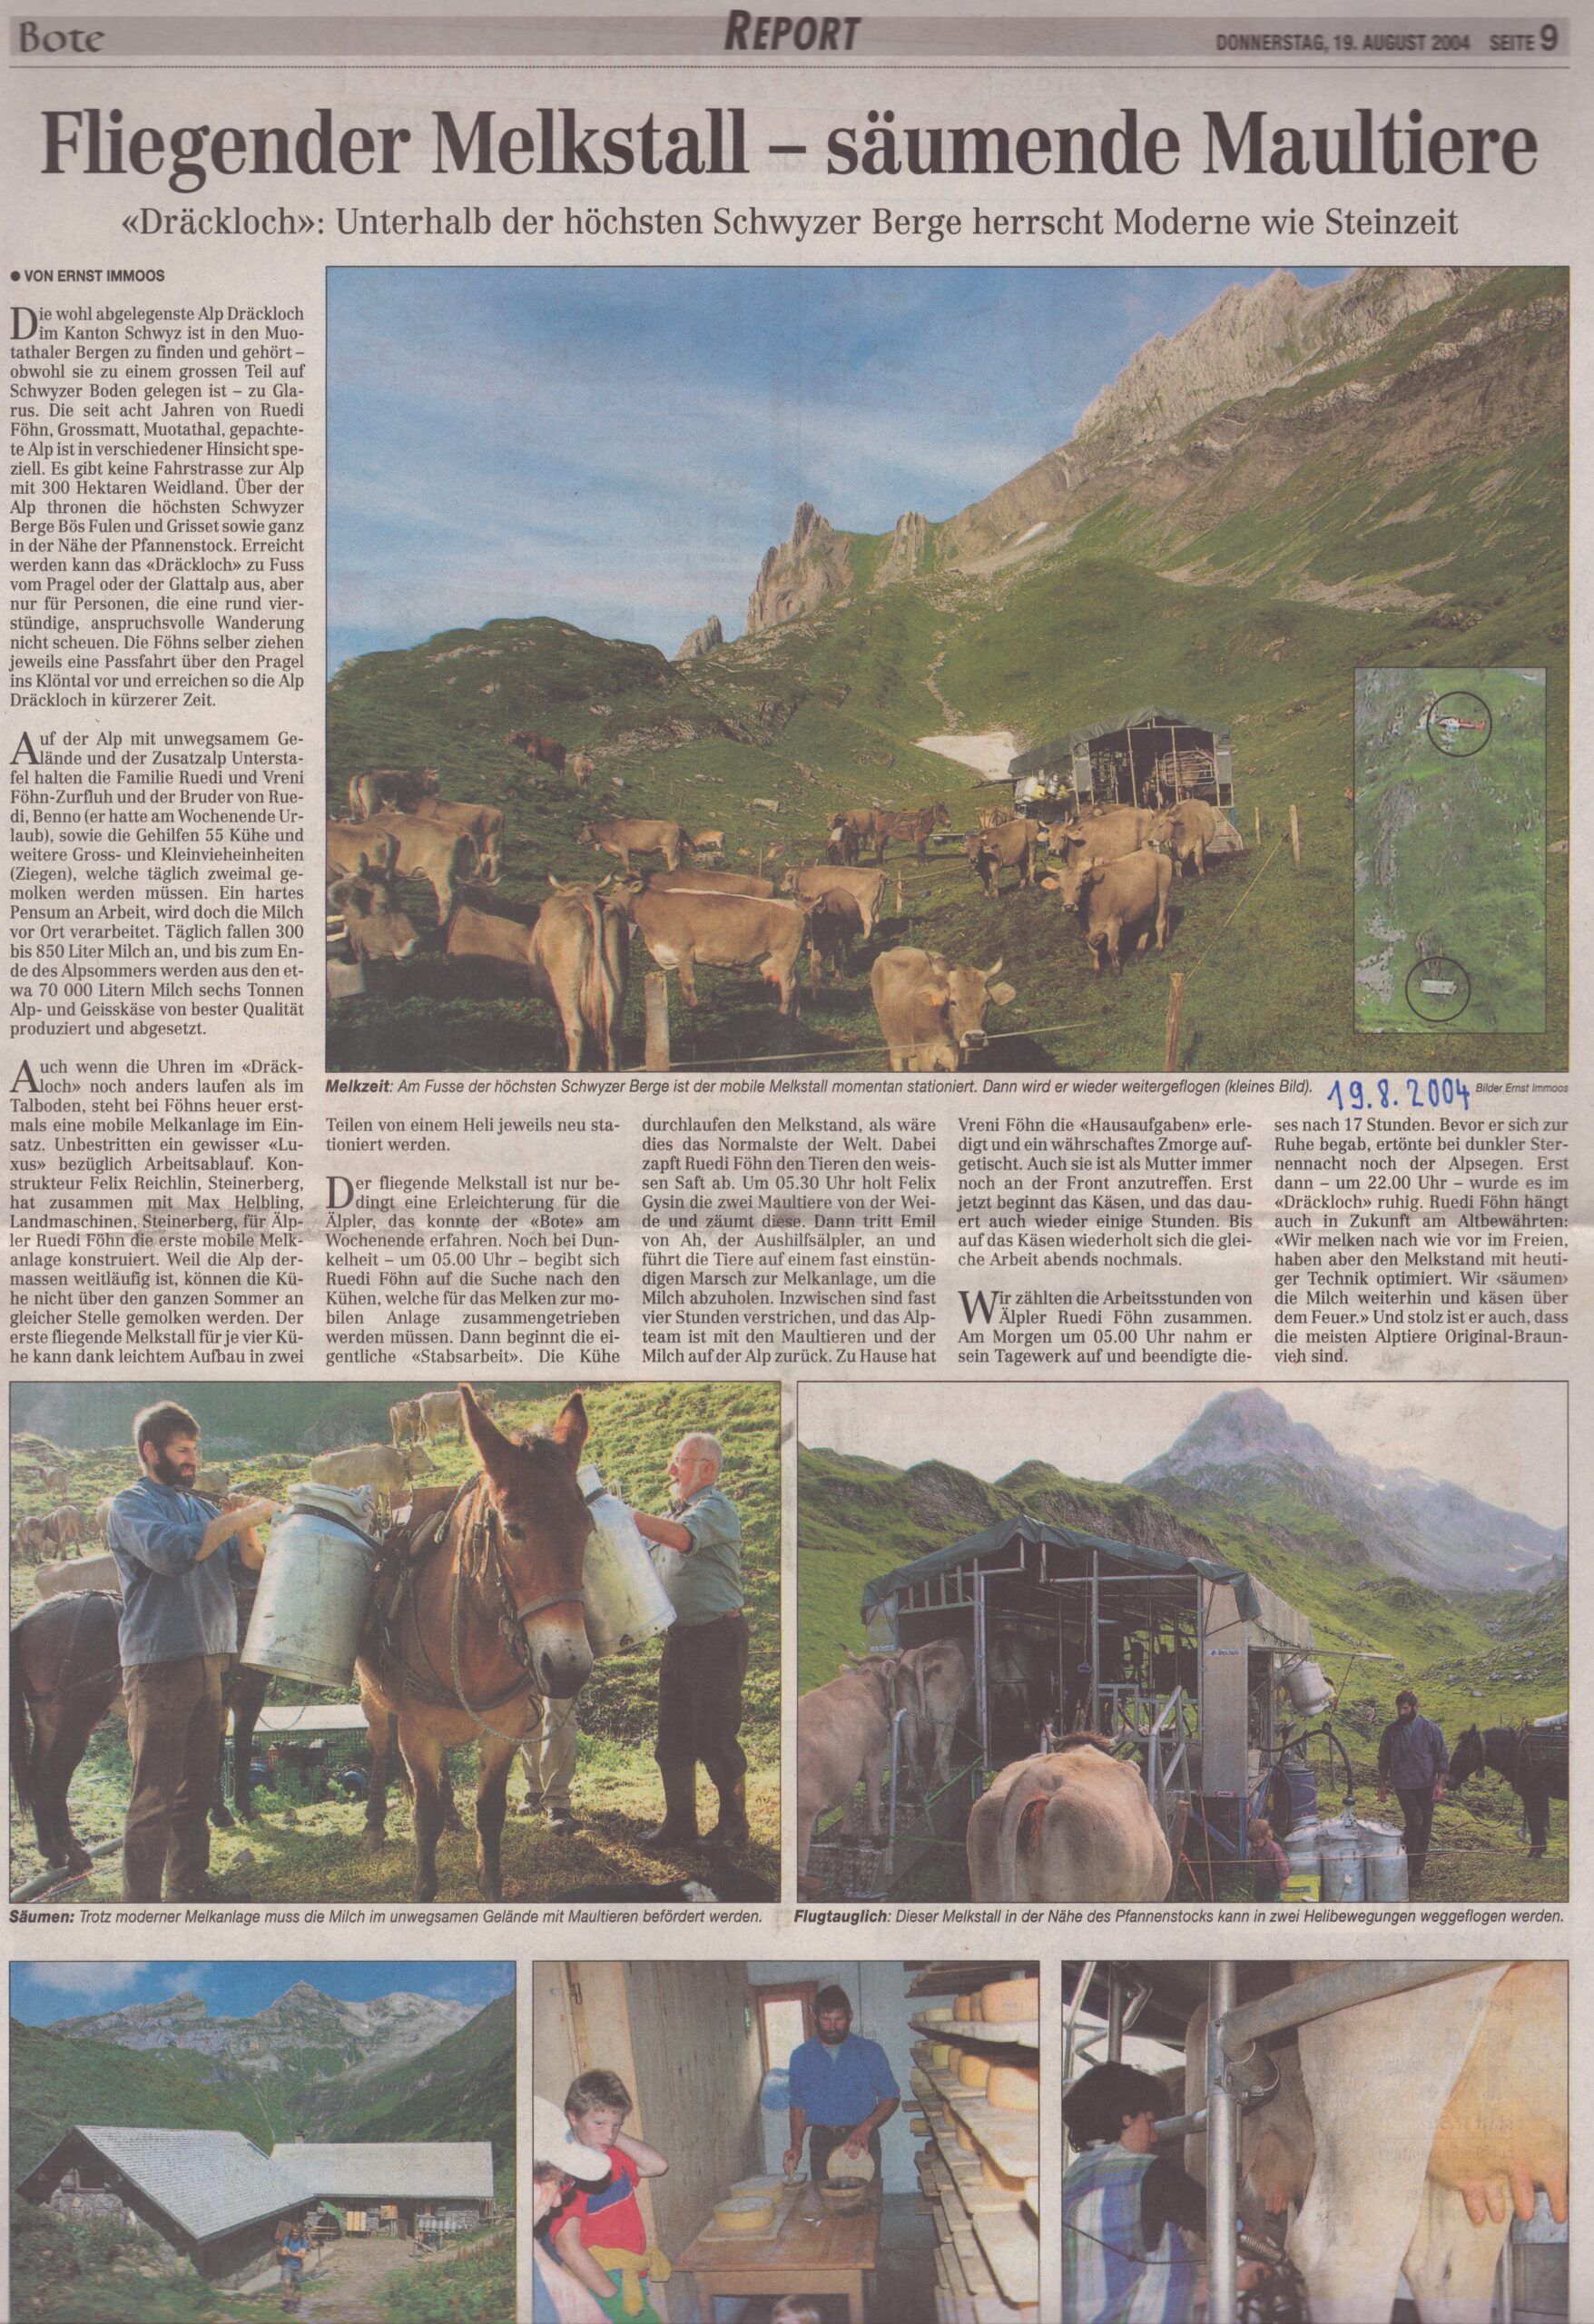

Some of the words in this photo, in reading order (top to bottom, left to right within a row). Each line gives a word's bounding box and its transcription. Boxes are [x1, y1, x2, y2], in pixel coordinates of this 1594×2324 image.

[20, 22, 104, 53] Bote
[724, 10, 861, 50] REPORT
[1490, 34, 1535, 52] SEITE
[1540, 24, 1558, 51] 9
[1216, 34, 1329, 54] DONNERSTAG,
[1333, 34, 1358, 52] 19.
[1362, 34, 1427, 52] AUGUST
[1432, 34, 1471, 52] 2004
[42, 109, 410, 193] Fliegender
[432, 108, 749, 174] Melkstall
[828, 109, 1179, 174] säumende
[1204, 109, 1537, 174] Maultiere
[123, 207, 323, 234] «Dräckloch»:
[337, 207, 490, 234] Unterhalb
[503, 207, 553, 234] der
[565, 207, 703, 234] höchsten
[714, 207, 861, 241] Schwyzer
[873, 209, 961, 241] Berge
[973, 207, 1104, 234] herrscht
[1115, 207, 1250, 234] Moderne
[1261, 207, 1314, 235] wie
[1325, 207, 1459, 235] Steinzeit
[24, 269, 54, 282] VON
[57, 269, 103, 282] ERNST
[106, 269, 165, 282] IMMOOS
[10, 421, 54, 438] Föhn,
[57, 422, 140, 438] Grossmatt,
[143, 421, 226, 438] Muotathal,
[229, 421, 304, 440] gepachte-
[9, 499, 36, 517] Alp
[46, 499, 107, 515] thronen
[118, 498, 141, 514] die
[153, 498, 221, 514] höchsten
[231, 498, 305, 517] Schwyzer
[10, 615, 79, 634] stündige,
[91, 615, 204, 634] anspruchsvolle
[215, 615, 305, 634] Wanderung
[10, 692, 87, 707] Dräckloch
[92, 693, 106, 707] in
[111, 692, 178, 707] kürzerer
[182, 692, 216, 707] Zeit.
[10, 789, 113, 804] Föhn-Zurfluh
[117, 789, 146, 804] und
[150, 789, 176, 803] der
[180, 789, 234, 803] Bruder
[237, 793, 264, 803] von
[268, 789, 304, 804] Rue-
[9, 885, 66, 900] molken
[77, 884, 135, 900] werden
[145, 885, 208, 900] müssen.
[219, 885, 244, 900] Ein
[255, 884, 304, 900] hartes
[10, 1020, 91, 1039] produziert
[95, 1020, 124, 1036] und
[130, 1020, 206, 1039] abgesetzt.
[325, 1078, 394, 1093] Melkzeit:
[397, 1078, 420, 1093] Am
[424, 1078, 465, 1093] Fusse
[468, 1079, 492, 1093] der
[494, 1078, 556, 1093] höchsten
[560, 1078, 626, 1097] Schwyzer
[629, 1078, 670, 1097] Berge
[673, 1078, 690, 1093] ist
[693, 1079, 717, 1093] der
[719, 1078, 765, 1093] mobile
[769, 1078, 829, 1093] Melkstall
[831, 1079, 903, 1093] momentan
[907, 1078, 978, 1093] stationiert.
[982, 1078, 1018, 1093] Dann
[1022, 1078, 1051, 1093] wird
[1054, 1082, 1069, 1093] er
[1072, 1078, 1118, 1093] wieder
[1121, 1078, 1221, 1097] weitergeflogen
[1225, 1078, 1275, 1096] (kleines
[1279, 1078, 1313, 1096] Bild).
[1475, 1082, 1504, 1093] Bilder
[1505, 1082, 1530, 1093] Ernst
[1531, 1083, 1569, 1093] Immoos
[642, 1117, 736, 1132] durchlaufen
[743, 1117, 771, 1132] den
[778, 1117, 862, 1134] Melkstand,
[869, 1117, 891, 1132] als
[896, 1118, 936, 1132] wäre
[326, 1137, 383, 1151] tioniert
[388, 1136, 450, 1151] werden.
[1274, 1155, 1347, 1171] nennacht
[1359, 1155, 1397, 1170] noch
[1410, 1155, 1436, 1170] der
[1448, 1155, 1523, 1175] Alpsegen.
[1538, 1156, 1569, 1170] Erst
[9, 1175, 84, 1190] strukteur
[90, 1175, 127, 1190] Felix
[134, 1175, 202, 1192] Reichlin,
[208, 1175, 303, 1194] Steinerberg,
[958, 1175, 996, 1190] noch
[1004, 1179, 1024, 1190] an
[1031, 1175, 1058, 1190] der
[1067, 1176, 1110, 1190] Front
[1117, 1175, 1212, 1190] anzutreffen.
[1221, 1176, 1253, 1190] Erst
[641, 1236, 670, 1247] von
[680, 1232, 706, 1249] Ah,
[717, 1232, 744, 1247] der
[754, 1232, 865, 1251] Aushilfsälpler,
[876, 1236, 895, 1247] an
[906, 1232, 936, 1247] und
[958, 1251, 985, 1266] che
[989, 1251, 1039, 1266] Arbeit
[1043, 1251, 1098, 1266] abends
[1103, 1251, 1182, 1266] nochmals.
[326, 1309, 364, 1324] bilen
[386, 1309, 440, 1328] Anlage
[462, 1309, 620, 1328] zusammengetrieben
[325, 1348, 397, 1367] gentliche
[411, 1348, 523, 1364] «Stabsarbeit».
[539, 1348, 565, 1364] Die
[580, 1348, 620, 1364] Kühe
[1274, 1348, 1307, 1363] vieh
[1311, 1347, 1348, 1363] sind.
[8, 1909, 75, 1924] Säumen:
[80, 1909, 113, 1924] Trotz
[115, 1909, 182, 1924] moderner
[184, 1909, 261, 1926] Melkanlage
[264, 1912, 300, 1924] muss
[304, 1909, 325, 1924] die
[329, 1909, 365, 1924] Milch
[369, 1909, 386, 1923] im
[389, 1912, 478, 1926] unwegsamen
[483, 1909, 539, 1924] Gelände
[542, 1909, 565, 1923] mit
[567, 1909, 639, 1924] Maultieren
[642, 1909, 705, 1923] befördert
[709, 1909, 763, 1923] werden.
[793, 1909, 891, 1926] Flugtauglich:
[895, 1909, 940, 1923] Dieser
[942, 1909, 1002, 1924] Melkstall
[1005, 1909, 1018, 1923] in
[1021, 1909, 1045, 1923] der
[1048, 1909, 1083, 1924] Nähe
[1087, 1909, 1111, 1924] des
[1115, 1908, 1214, 1923] Pfannenstocks
[1217, 1909, 1250, 1923] kann
[1254, 1909, 1266, 1923] in
[1269, 1912, 1300, 1923] zwei
[1304, 1909, 1416, 1926] Helibewegungen
[1421, 1908, 1507, 1926] weggeflogen
[1510, 1909, 1564, 1923] werden.
